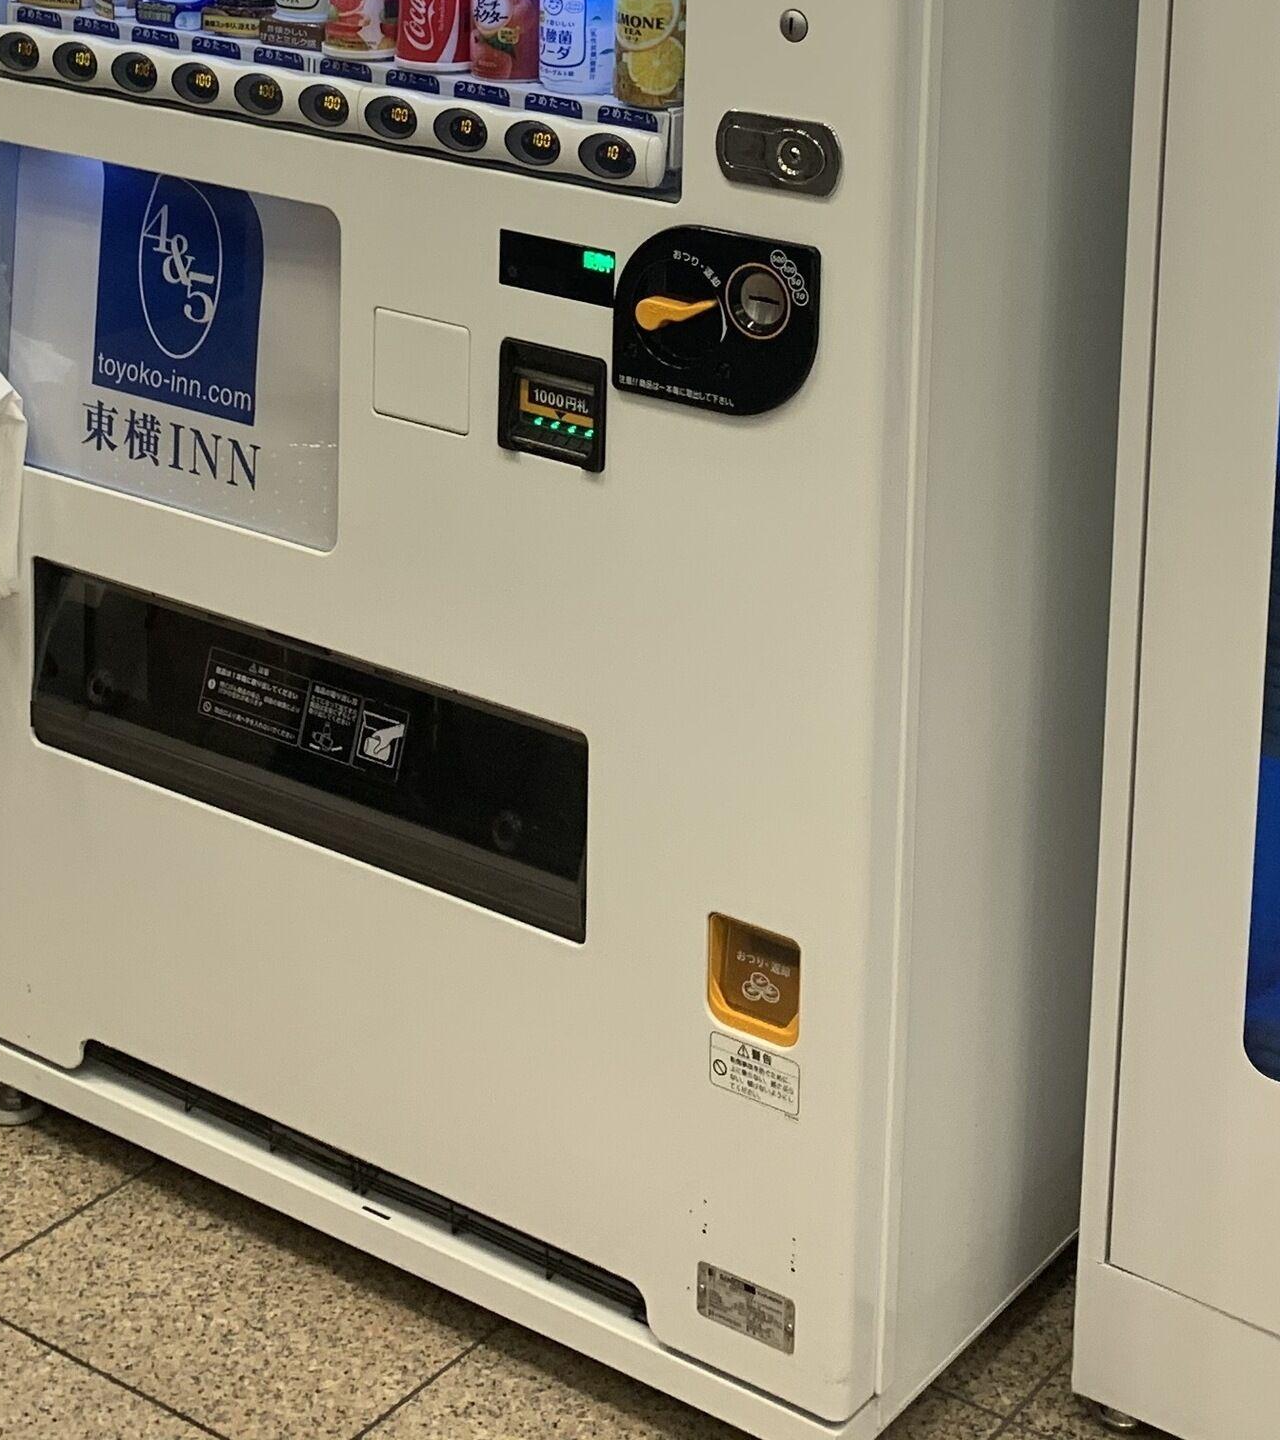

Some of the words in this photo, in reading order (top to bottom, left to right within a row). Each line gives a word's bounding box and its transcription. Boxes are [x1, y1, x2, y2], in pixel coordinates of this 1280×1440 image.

[97, 352, 252, 412] toyoko-inn.com
[533, 388, 588, 414] 1000円札
[81, 400, 262, 491] 東横INN
